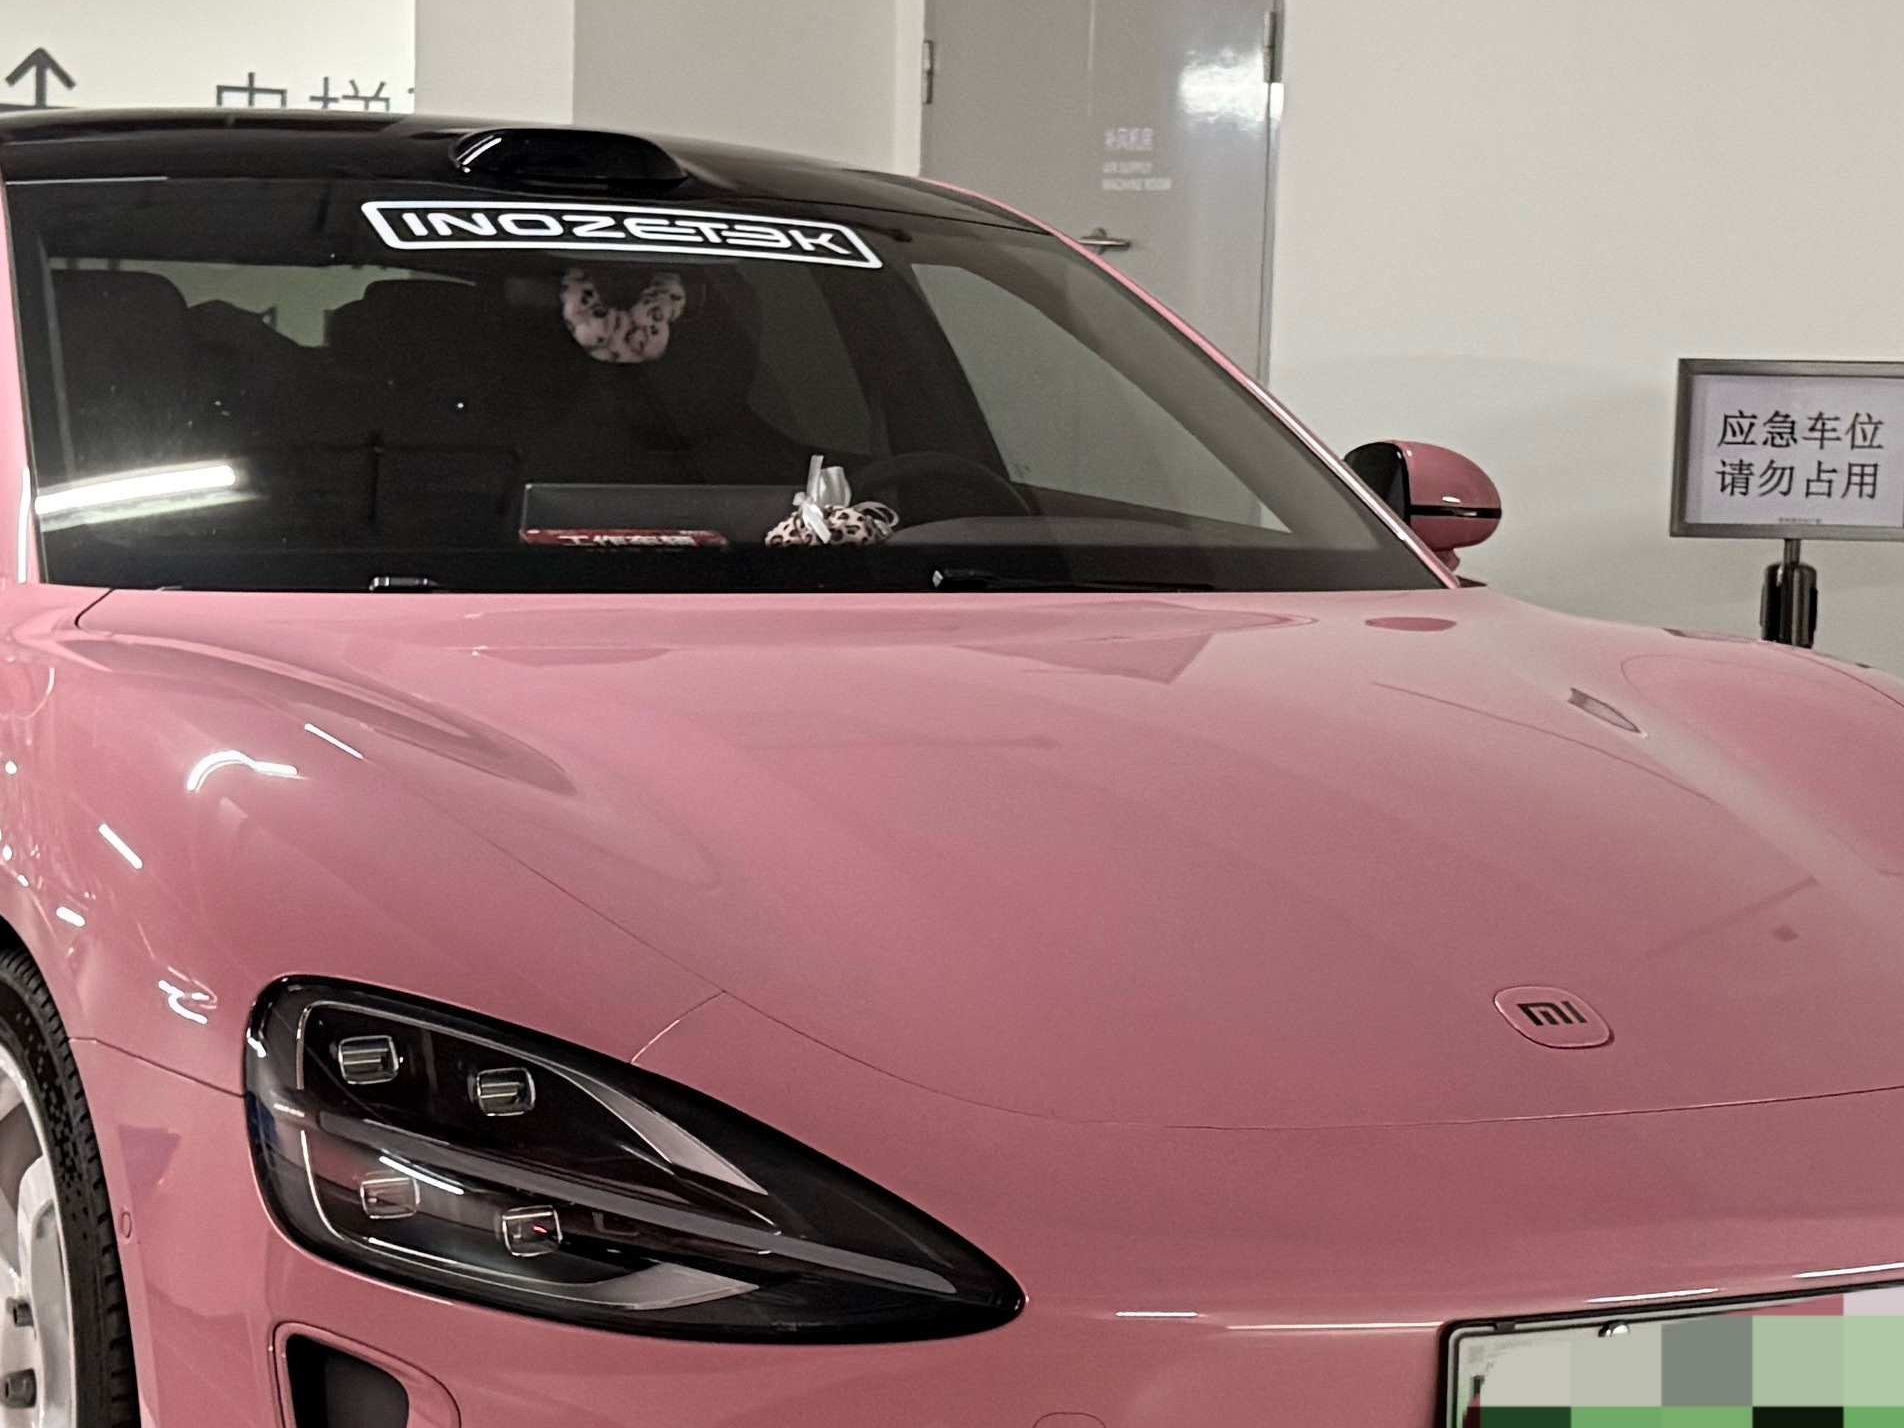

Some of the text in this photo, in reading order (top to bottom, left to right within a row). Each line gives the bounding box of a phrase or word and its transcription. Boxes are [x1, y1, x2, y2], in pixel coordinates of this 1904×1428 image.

[1716, 409, 1885, 451] 应急车位
[1715, 458, 1881, 500] 请勿占用
